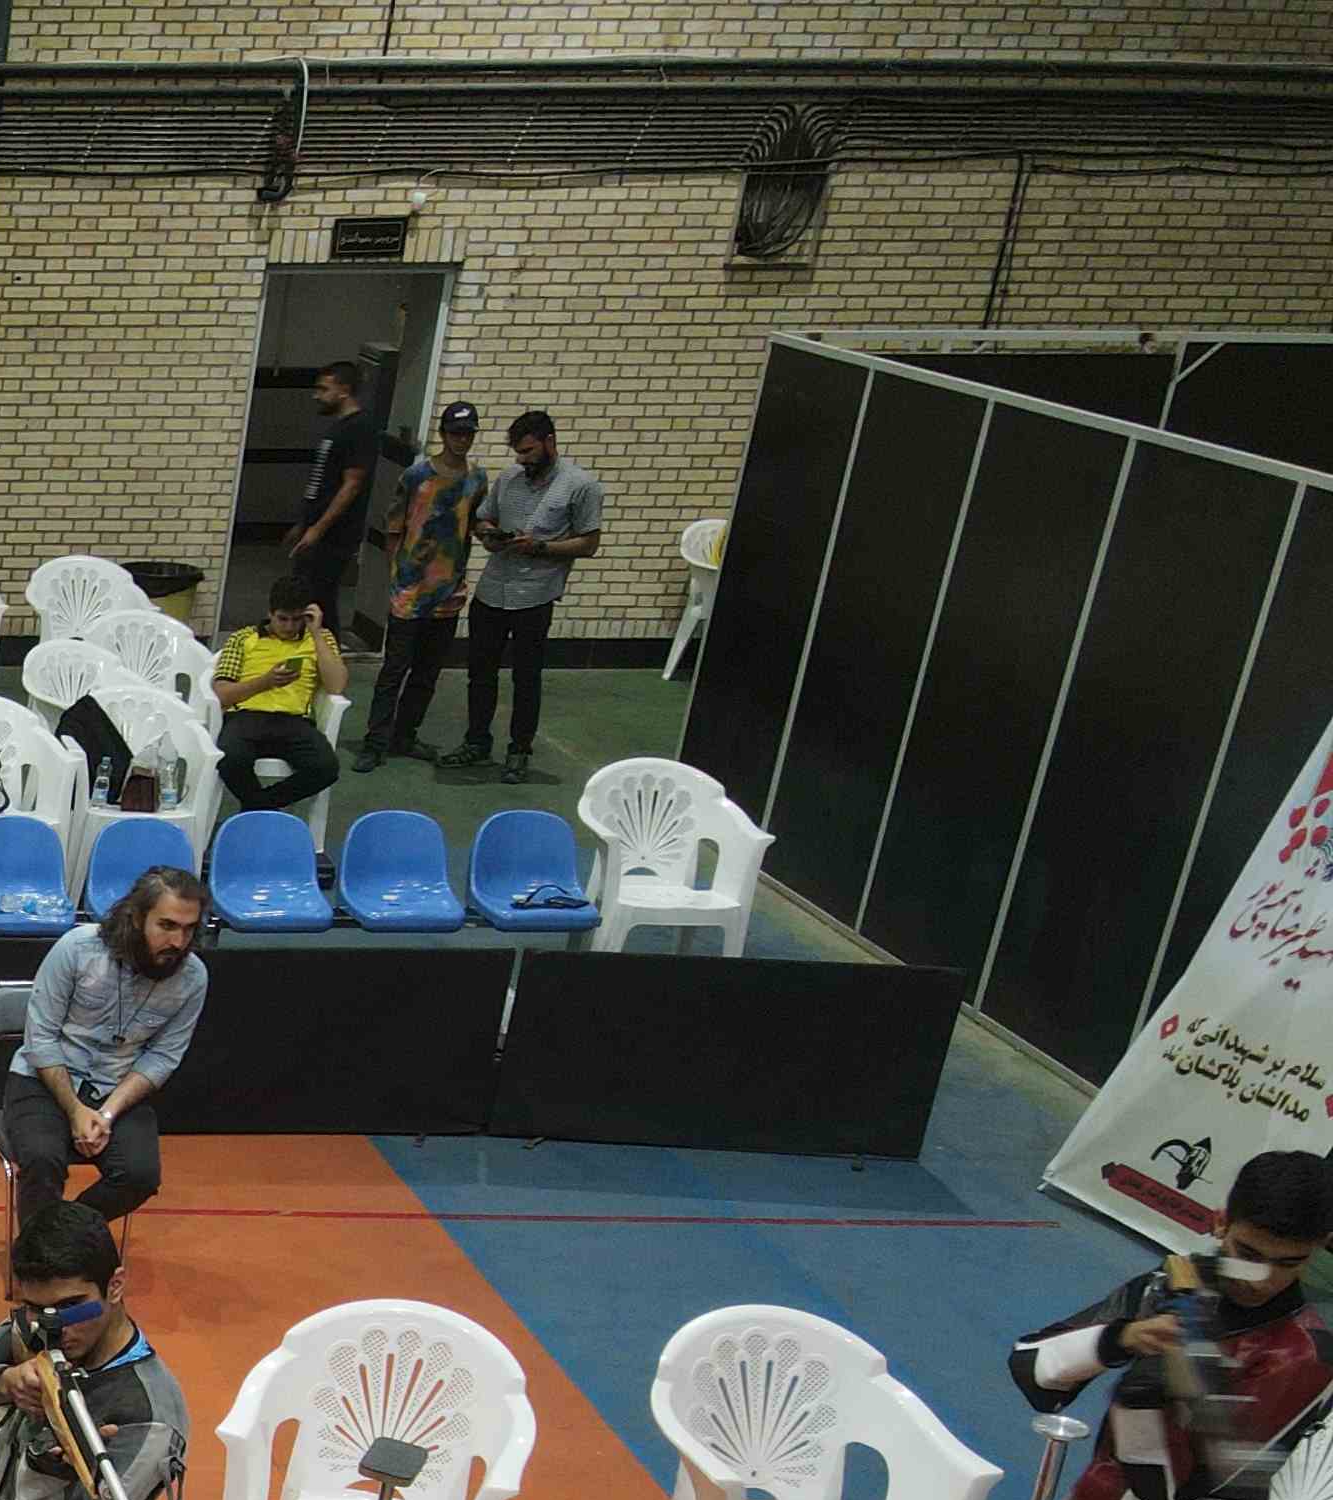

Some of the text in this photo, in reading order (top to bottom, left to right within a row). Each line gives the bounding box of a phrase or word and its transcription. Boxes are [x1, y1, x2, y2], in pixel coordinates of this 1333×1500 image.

[1193, 1023, 1270, 1065] شهیدانی
[1263, 1058, 1286, 1078] بر
[1281, 1062, 1326, 1090] سلام
[1238, 1082, 1310, 1122] مدالشان
